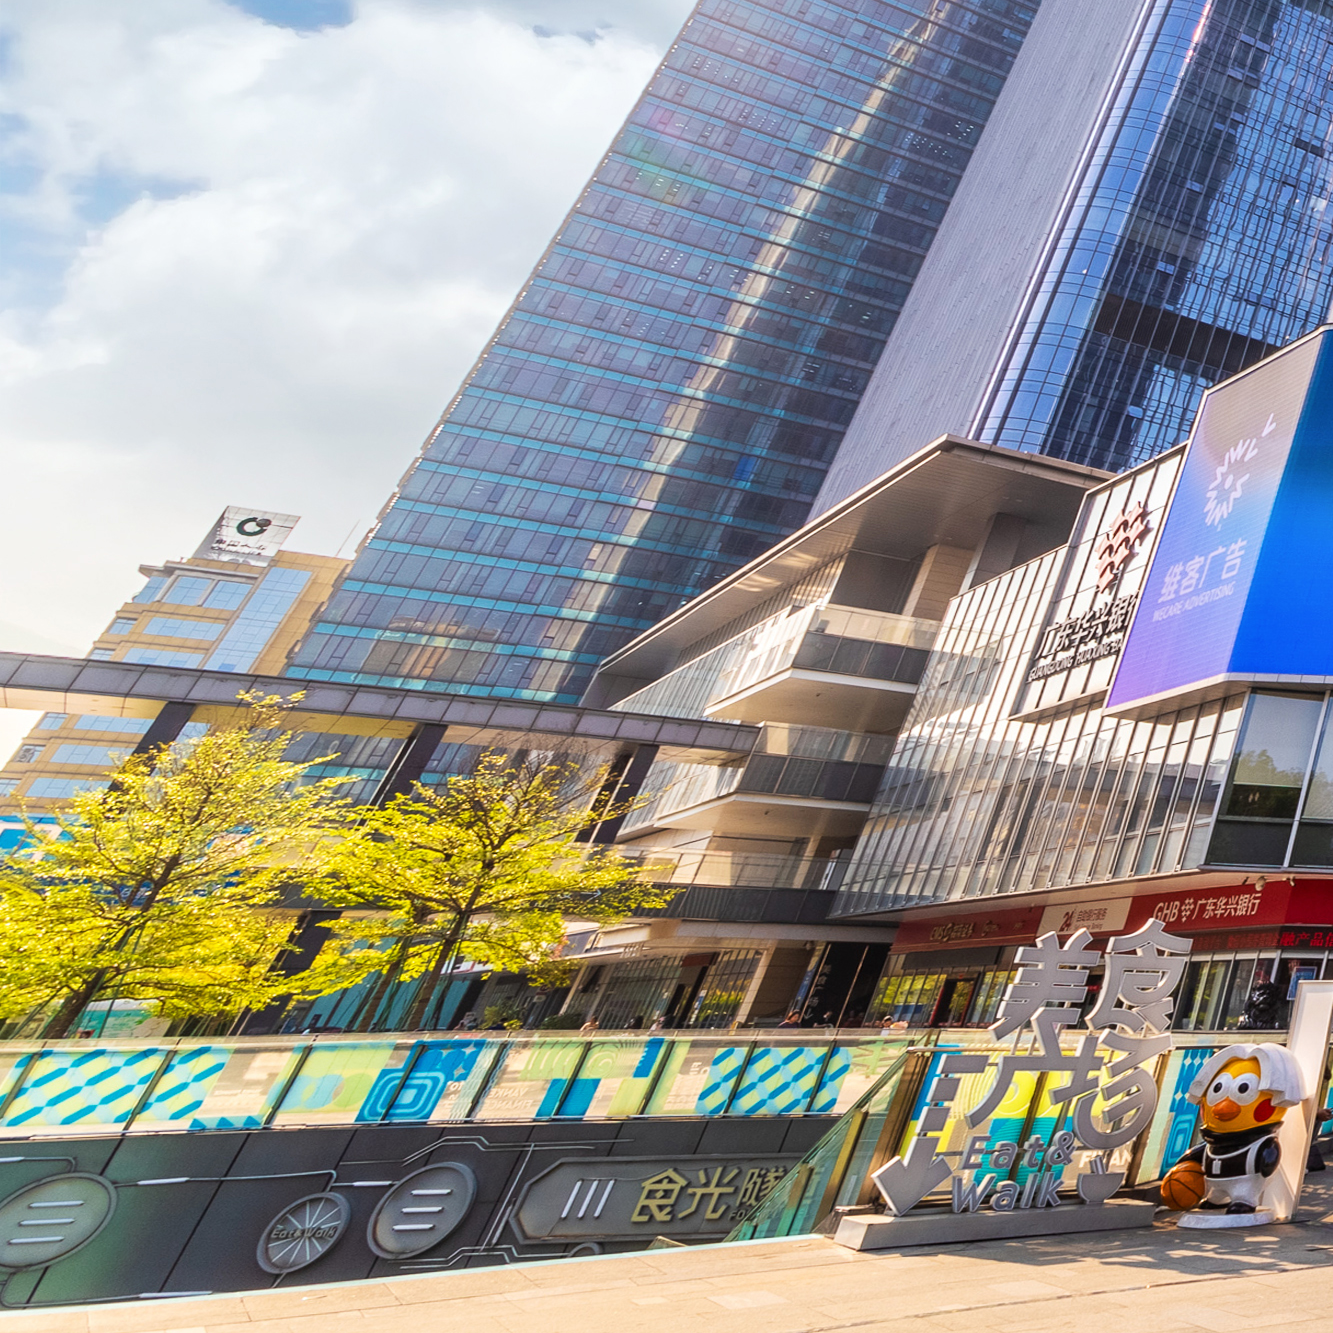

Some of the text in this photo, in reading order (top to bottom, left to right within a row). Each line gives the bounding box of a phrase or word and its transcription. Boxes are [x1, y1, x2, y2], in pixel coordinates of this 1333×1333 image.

[1157, 538, 1246, 603] 维客广告
[1153, 581, 1236, 622] WECARE ADVERTISING
[1153, 900, 1180, 923] GHB
[1191, 893, 1262, 921] 广东华兴银行
[951, 1172, 1065, 1214] Walk
